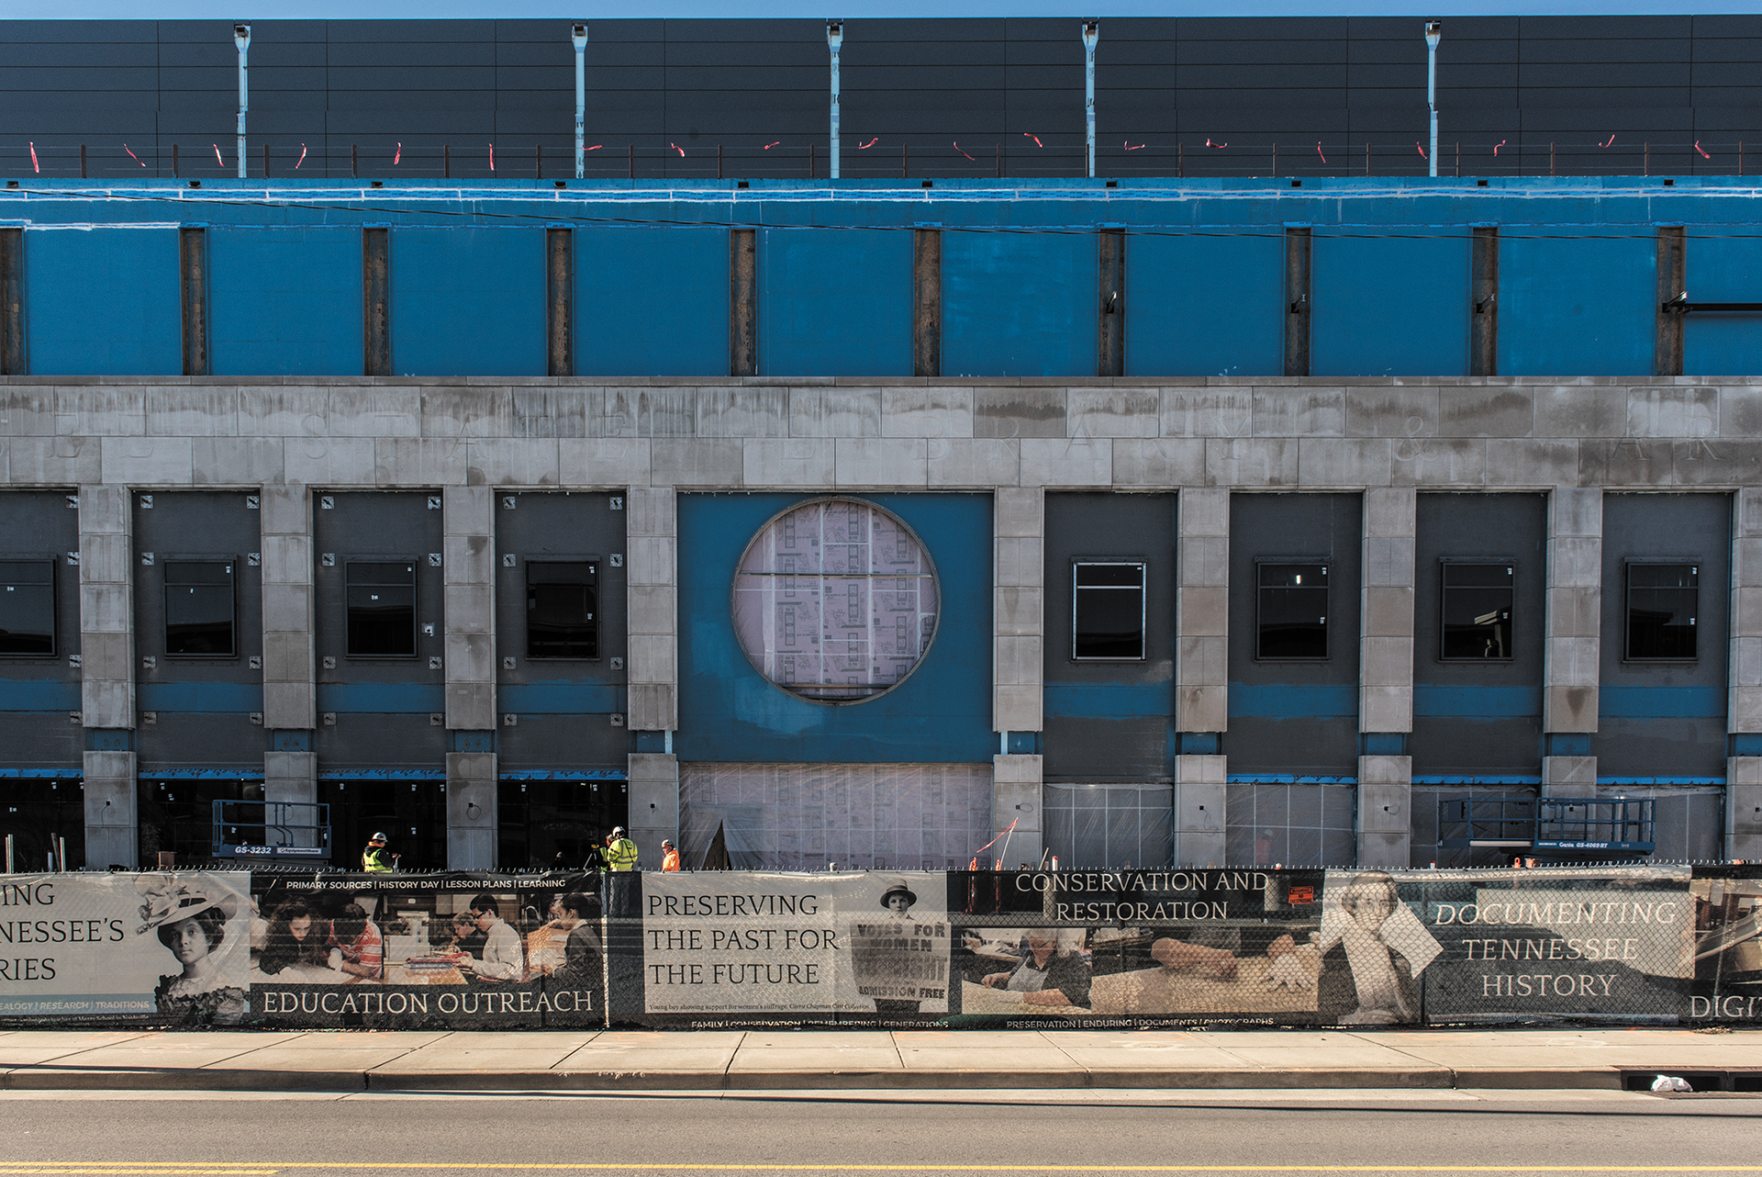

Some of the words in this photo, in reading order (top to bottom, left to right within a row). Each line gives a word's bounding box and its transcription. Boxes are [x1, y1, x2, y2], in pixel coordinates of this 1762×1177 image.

[301, 413, 630, 460] STATE
[780, 413, 1252, 460] LIBRARY
[1395, 416, 1439, 461] &
[235, 846, 272, 854] GS-3232
[286, 881, 328, 889] PRIMARY
[329, 881, 372, 889] SOURCES
[379, 881, 419, 889] HISTORY
[420, 881, 440, 889] DAY
[445, 880, 481, 889] LESSON
[482, 880, 512, 889] PLANS
[518, 879, 566, 888] LEARNING
[1015, 872, 1208, 892] CONSERVATION
[1214, 872, 1270, 891] AND
[1, 883, 55, 905] ING
[648, 894, 819, 916] PRESERVING
[1055, 901, 1229, 921] RESTORATION
[1435, 902, 1677, 925] DOCUMENTING
[0, 918, 125, 943] NESSEE'S
[648, 929, 703, 950] THE
[712, 929, 777, 950] PAST
[785, 929, 840, 950] FOR
[857, 923, 903, 936] VOTES
[914, 923, 945, 937] FOR
[869, 938, 932, 952] WOMEN
[1461, 938, 1640, 961] TENNESSEE
[0, 957, 56, 980] RIES
[649, 964, 703, 984] THE
[713, 964, 819, 984] FUTURE
[859, 986, 915, 997] ADMISSION
[919, 987, 945, 999] FREE
[1481, 974, 1617, 997] HISTORY
[41, 1001, 89, 1010] RESEARCH
[95, 1000, 150, 1009] TRADITIONS
[263, 992, 427, 1013] EDUCATION
[438, 990, 594, 1013] OUTREACH
[1689, 995, 1762, 1018] DIGI
[883, 1020, 949, 1028] GENERATIONS
[1006, 1020, 1076, 1028] PRESERVATION
[1083, 1019, 1132, 1028] ENDURING
